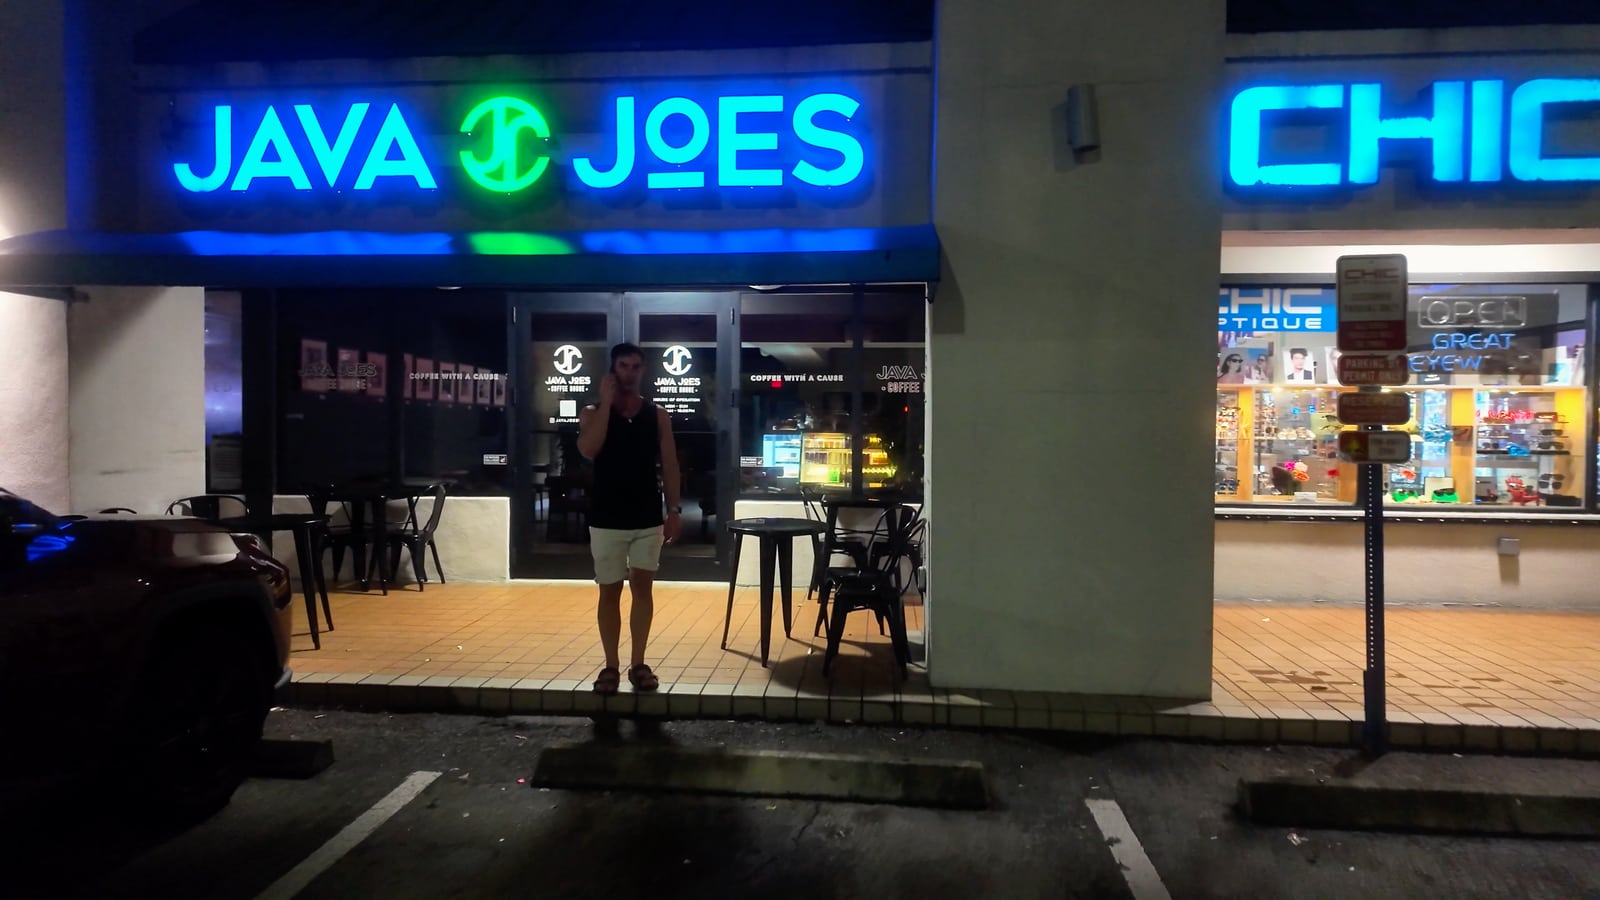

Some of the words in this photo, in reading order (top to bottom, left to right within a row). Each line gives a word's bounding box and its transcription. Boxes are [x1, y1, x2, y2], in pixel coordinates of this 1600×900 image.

[1230, 79, 1600, 186] CHIC
[174, 103, 437, 192] JAVA
[573, 93, 864, 189] JOES
[1219, 288, 1322, 314] HIC
[1427, 301, 1521, 324] OPEN
[1432, 333, 1516, 350] GREAT
[545, 376, 567, 385] JAVA
[568, 376, 591, 385] JOES
[750, 374, 782, 382] COFFEE
[784, 374, 806, 382] WITH
[808, 374, 815, 382] A
[816, 374, 844, 382] CAUSE
[876, 366, 918, 380] JAVA
[654, 378, 676, 386] JAVA
[678, 378, 701, 386] JOES
[887, 382, 920, 393] COFFEE
